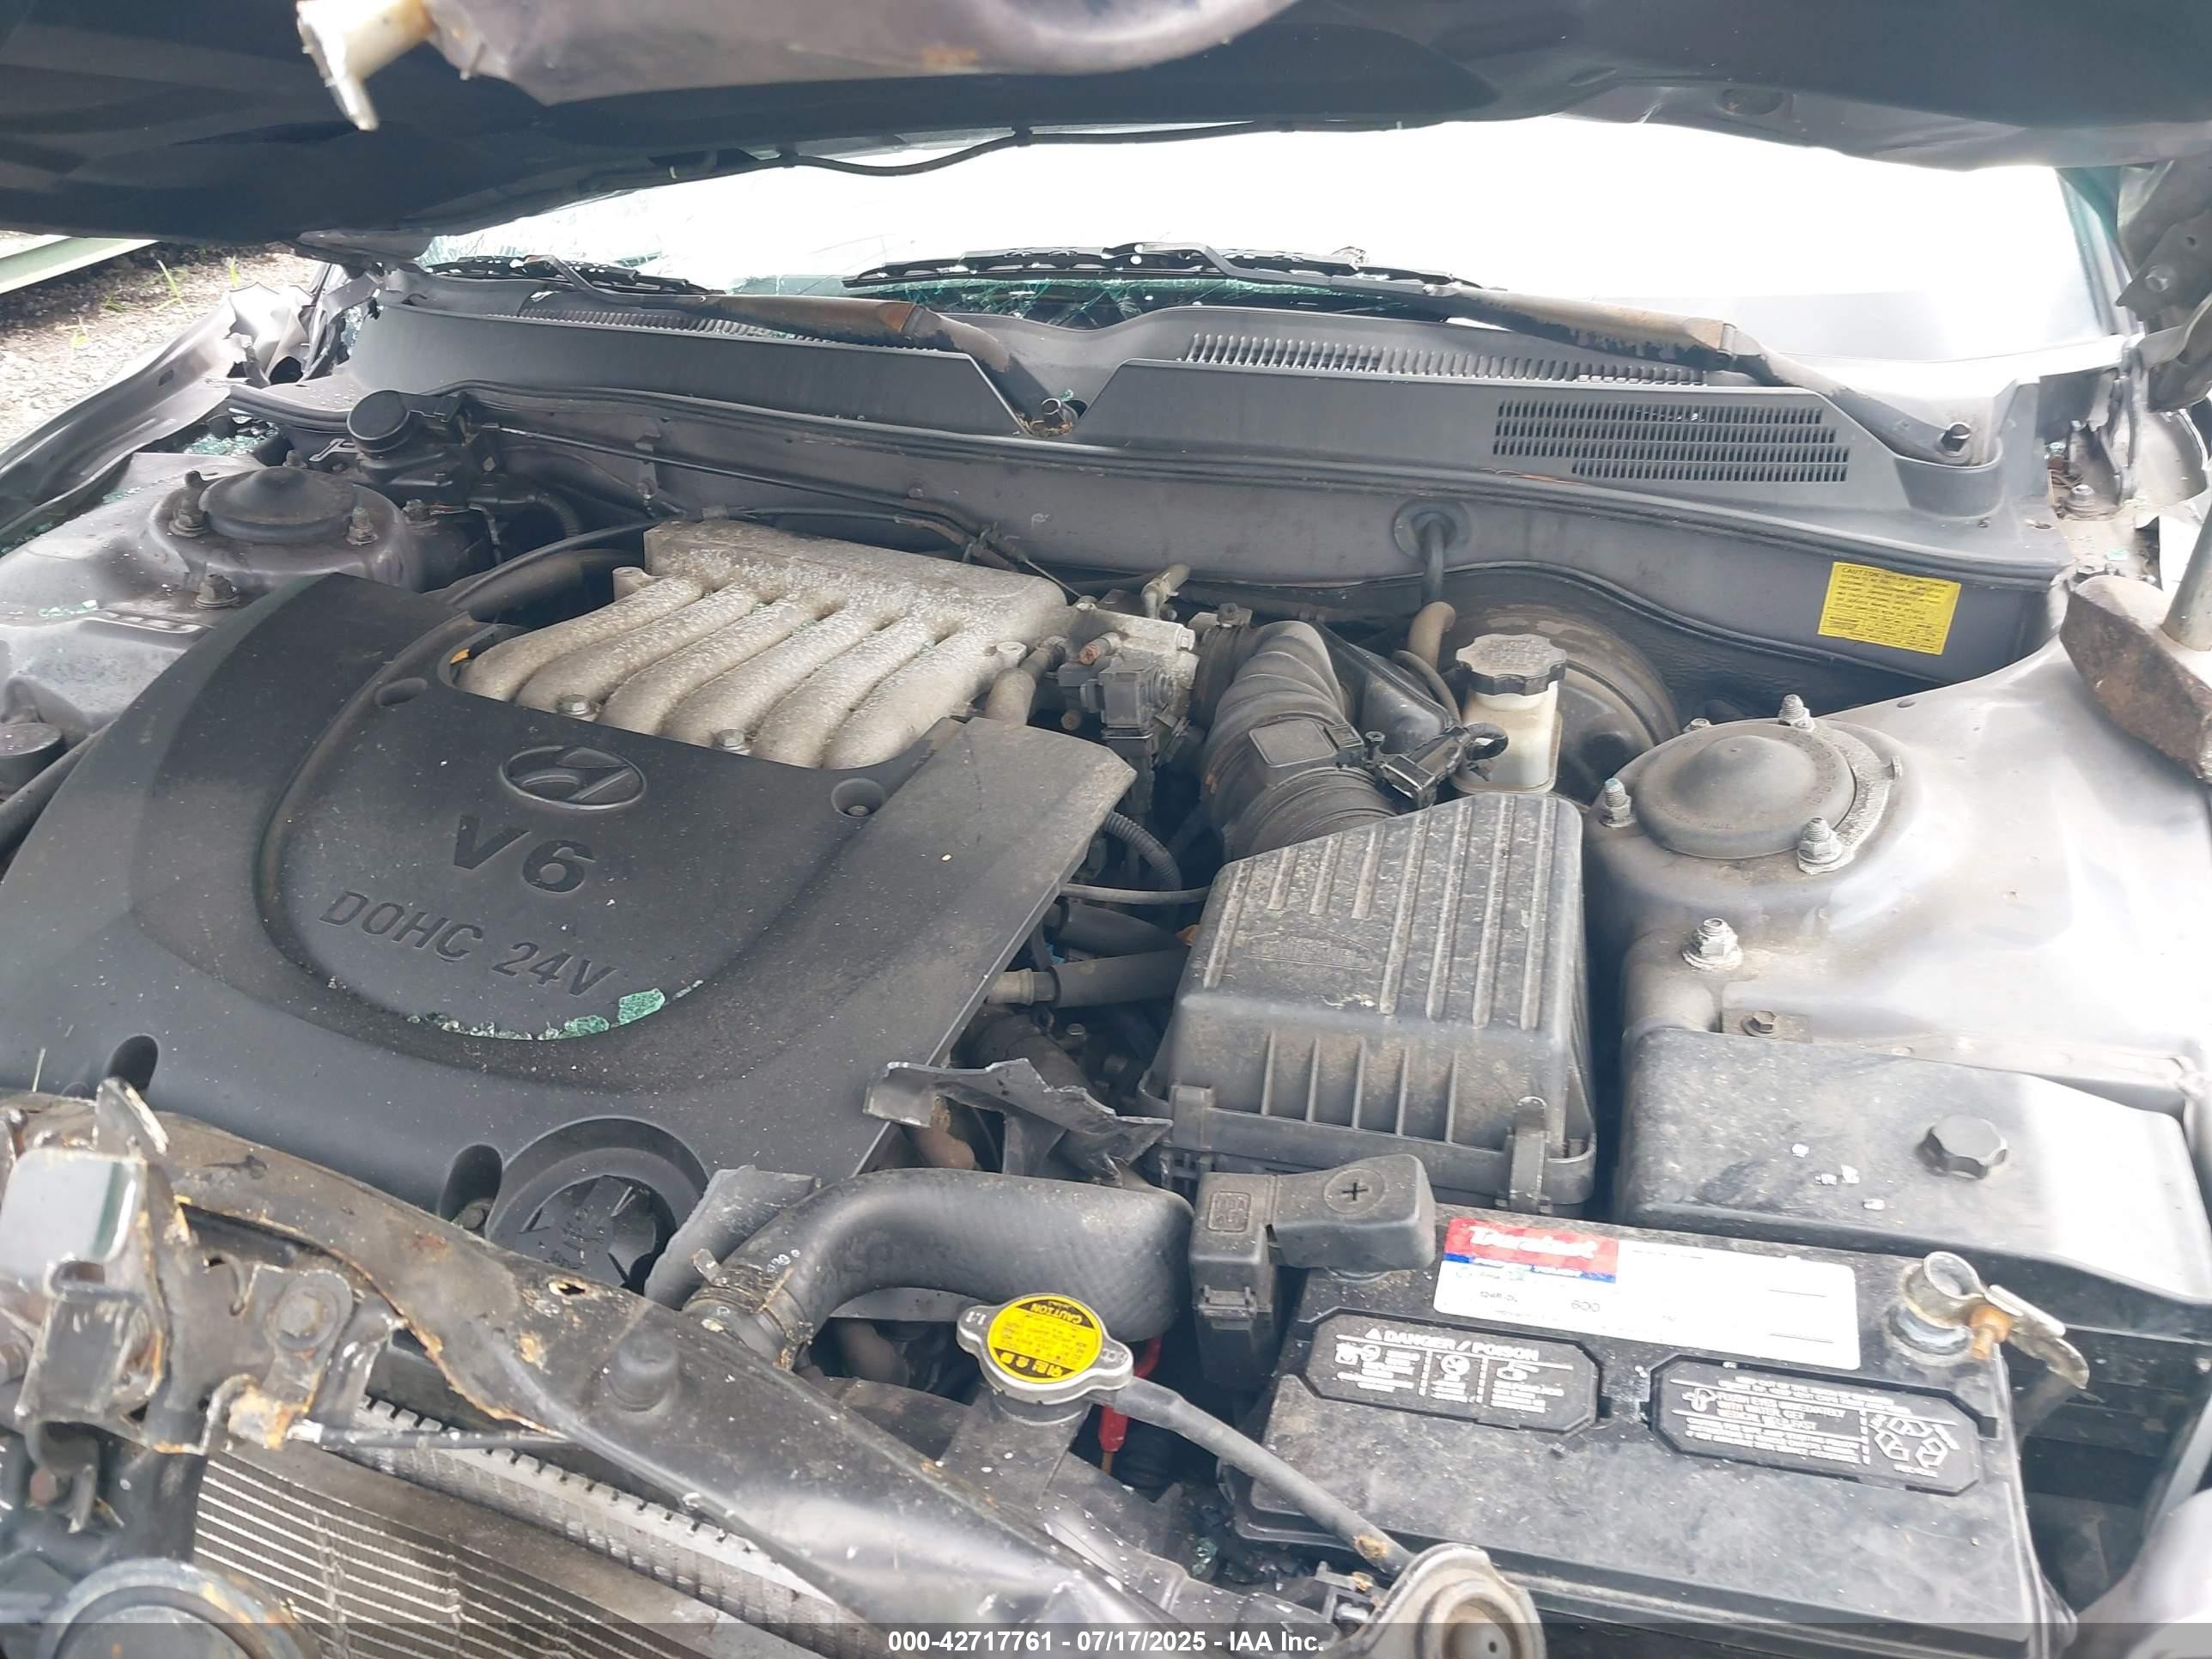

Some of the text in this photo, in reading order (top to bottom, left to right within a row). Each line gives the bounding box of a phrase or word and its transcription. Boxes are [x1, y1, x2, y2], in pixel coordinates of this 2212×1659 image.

[318, 890, 617, 998] DOHC 24V
[1030, 1302, 1084, 1324] CAUTION
[1571, 1298, 1601, 1313] 600
[1383, 1329, 1456, 1351] DANGER
[1471, 1341, 1540, 1362] POISON
